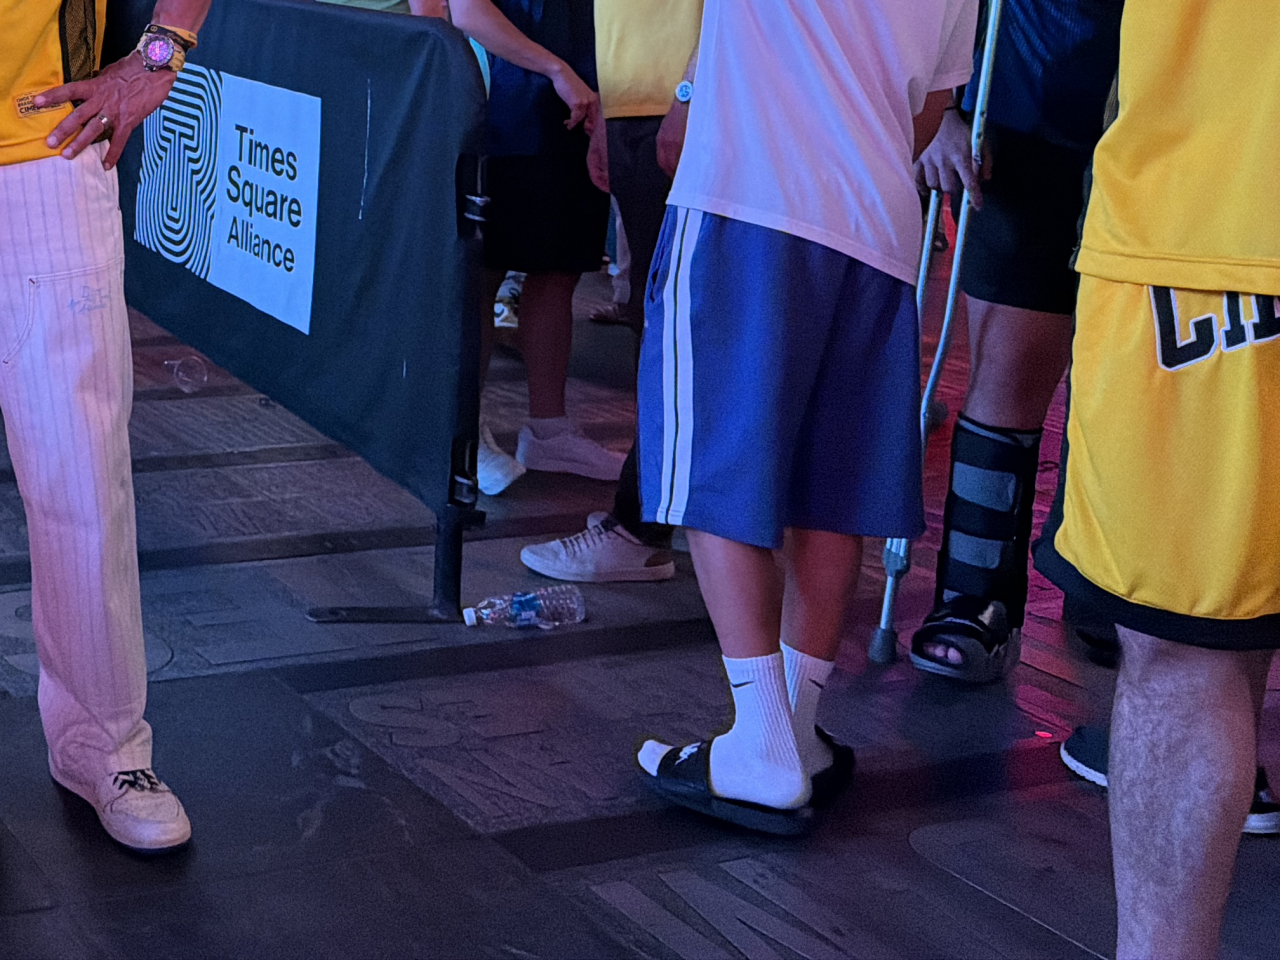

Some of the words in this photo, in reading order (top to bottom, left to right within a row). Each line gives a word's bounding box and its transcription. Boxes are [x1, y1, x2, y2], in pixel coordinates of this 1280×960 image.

[234, 123, 298, 181] Times
[226, 165, 302, 228] Square
[227, 216, 295, 273] Alliance
